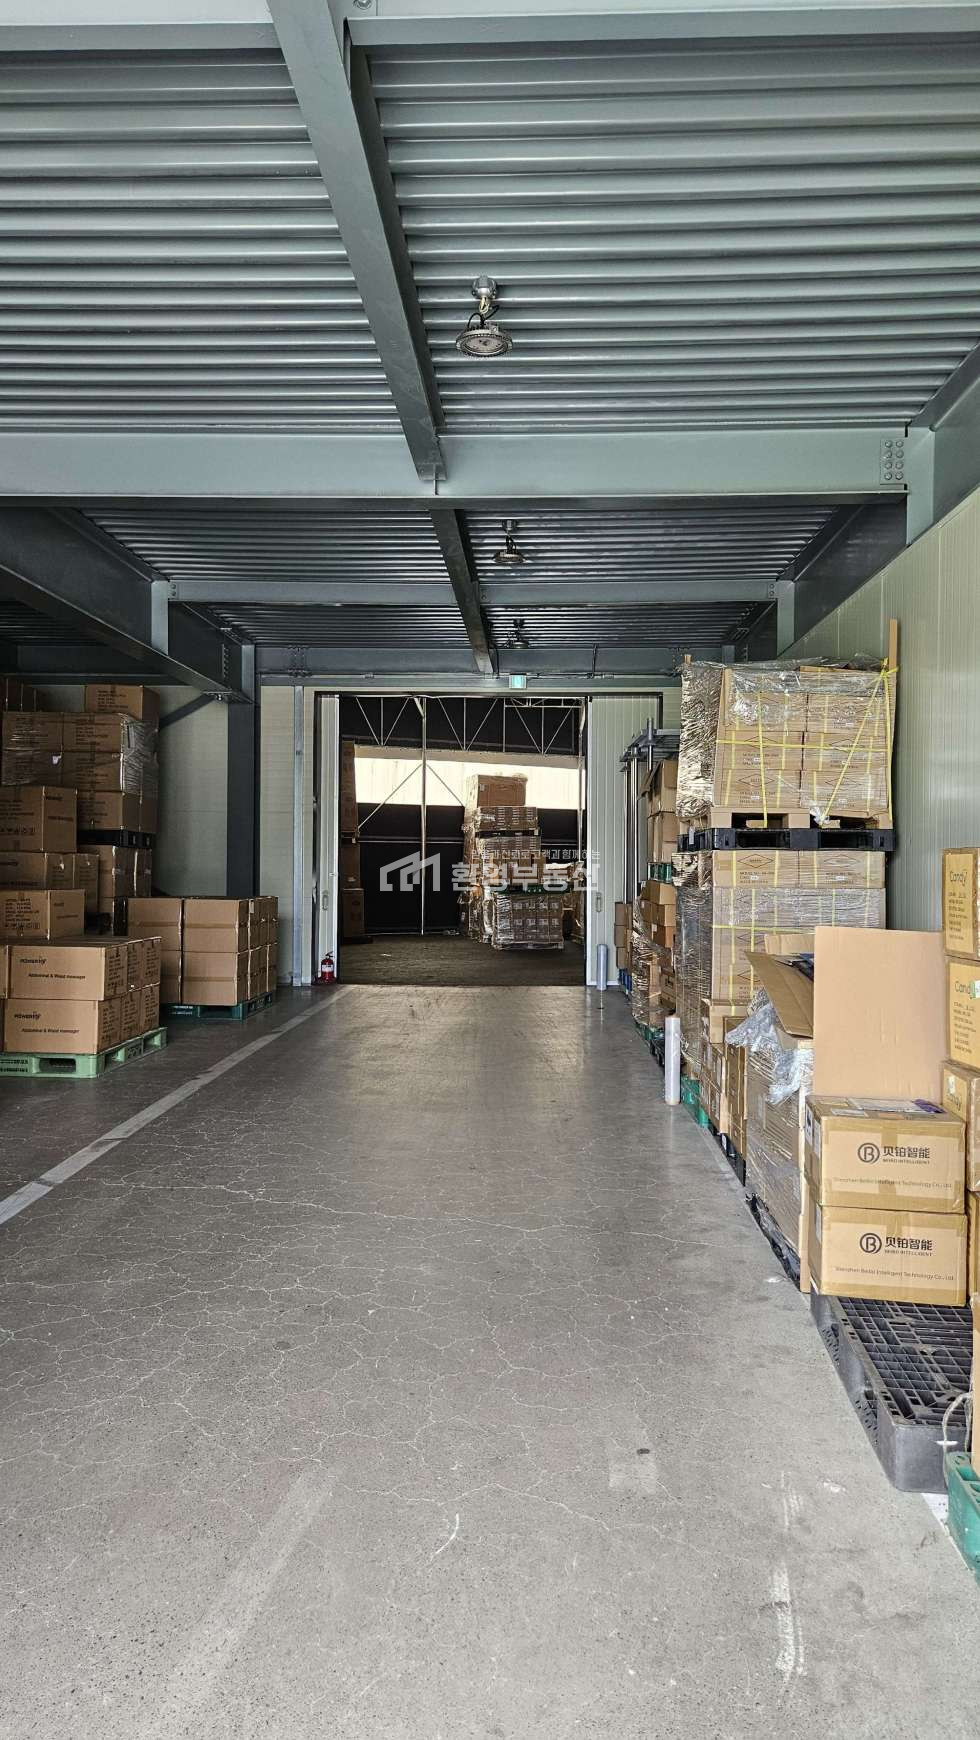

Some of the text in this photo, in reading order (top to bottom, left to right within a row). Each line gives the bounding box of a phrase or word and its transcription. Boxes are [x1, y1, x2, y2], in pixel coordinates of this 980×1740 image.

[950, 869, 968, 887] Candy
[954, 980, 976, 1000] Cand
[883, 1145, 931, 1159] 贝铂智能
[885, 1236, 933, 1251] 贝铂智能
